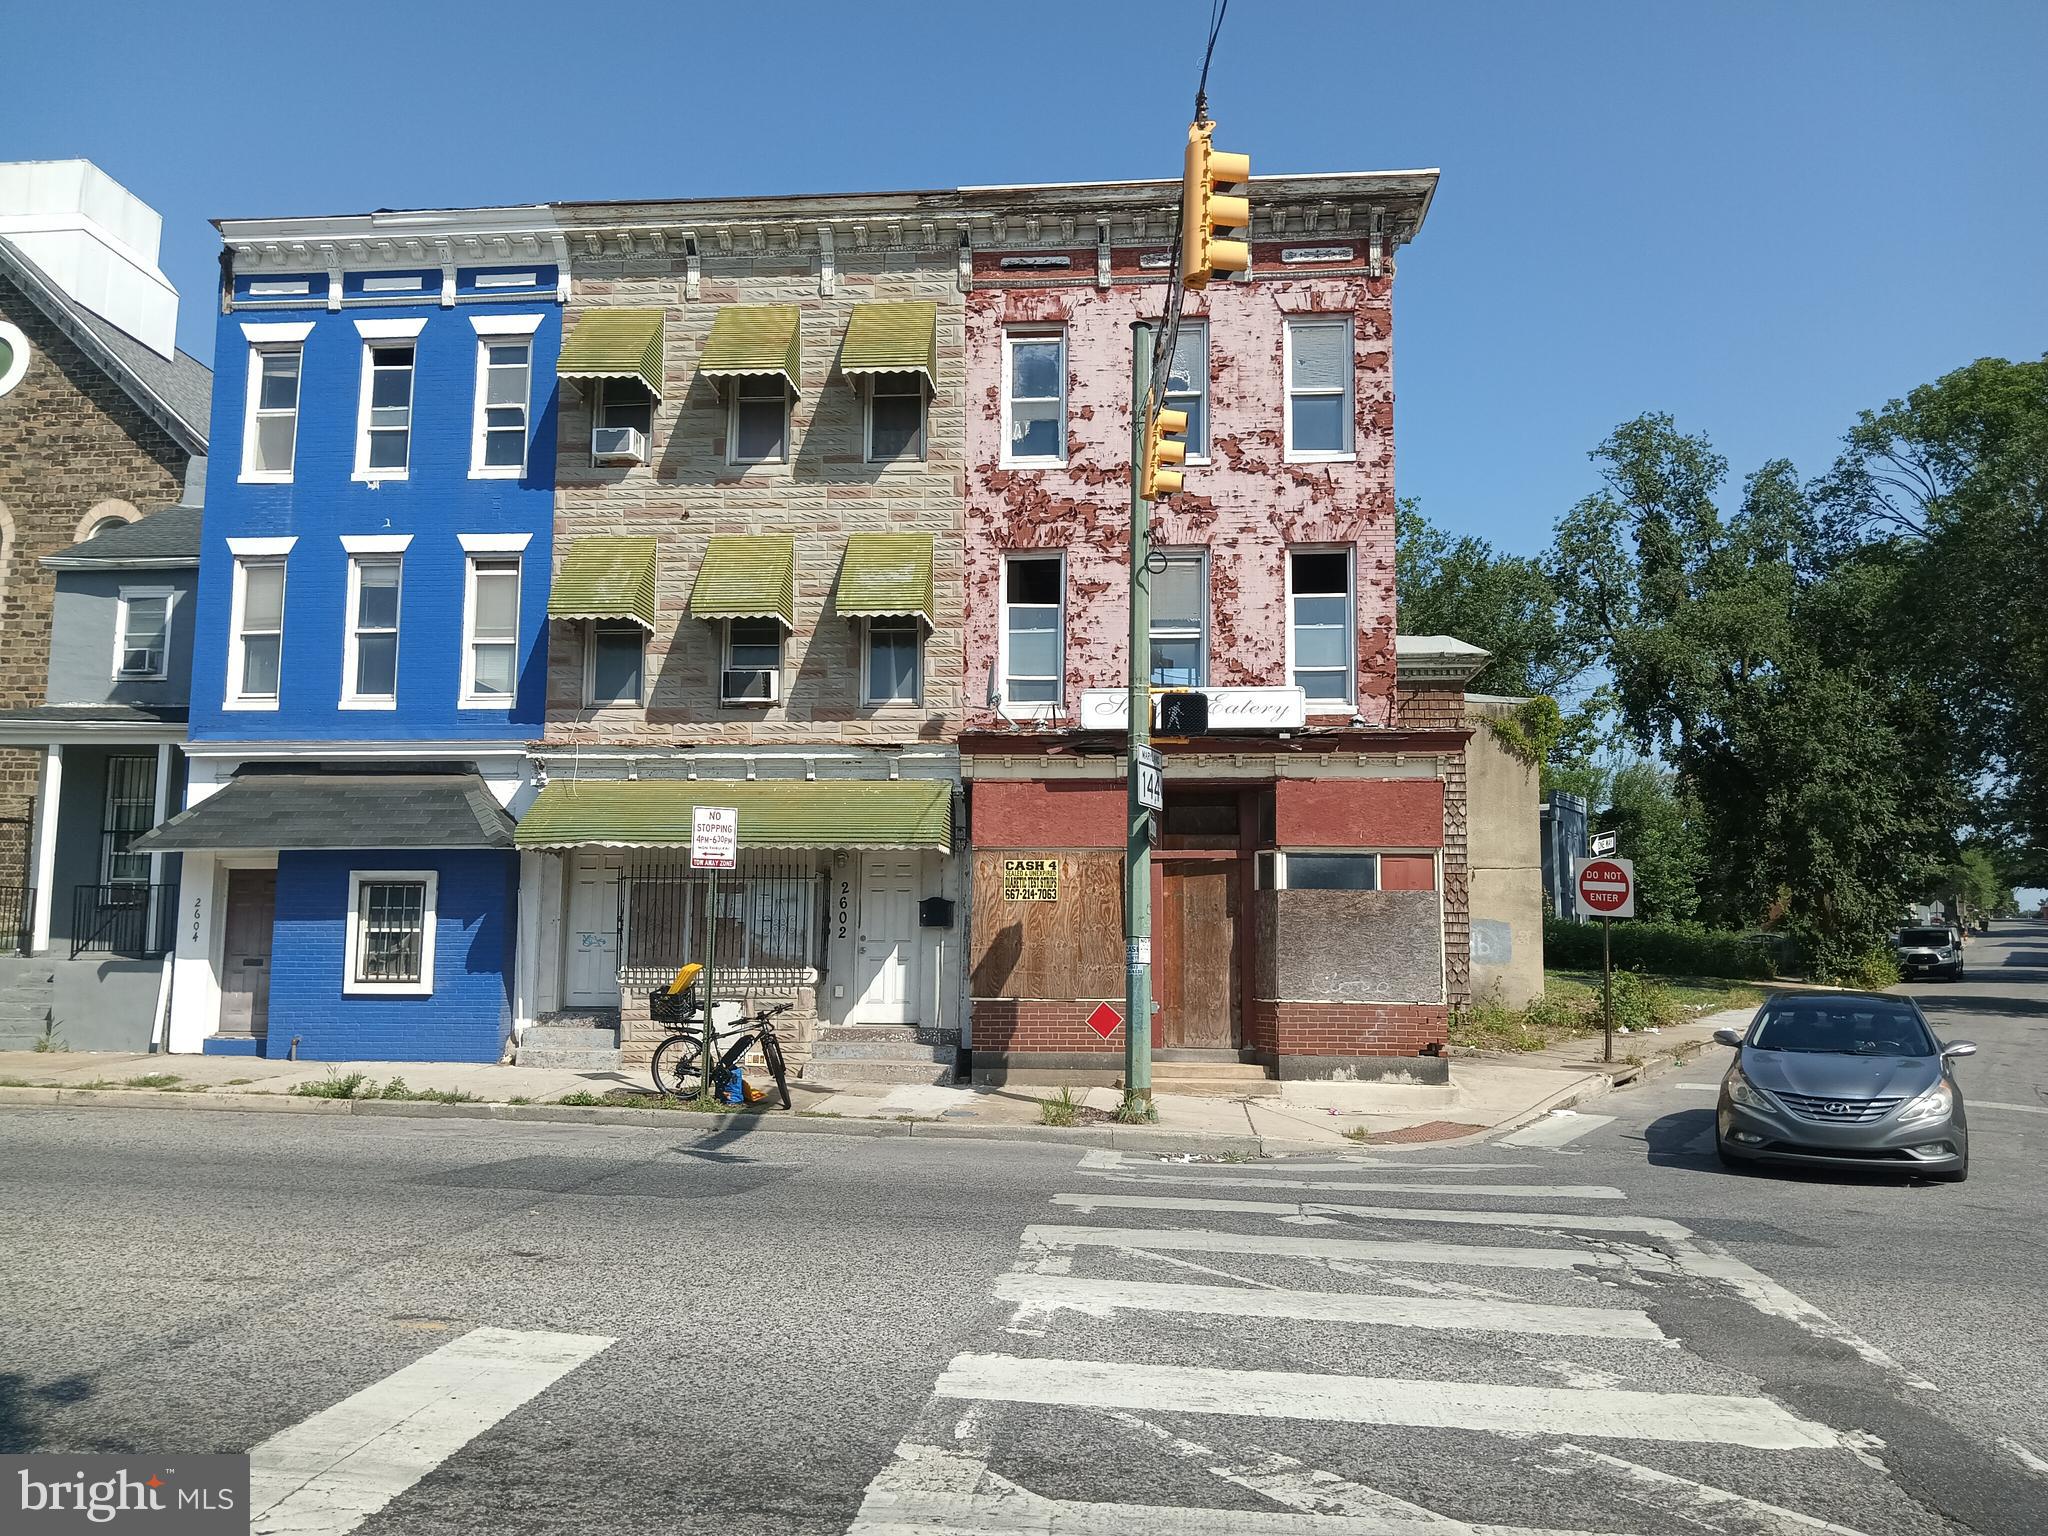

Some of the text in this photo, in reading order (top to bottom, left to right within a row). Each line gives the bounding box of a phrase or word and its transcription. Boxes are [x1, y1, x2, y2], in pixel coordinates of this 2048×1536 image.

[1208, 693, 1290, 722] Eatery
[1142, 771, 1160, 802] 144
[709, 811, 721, 821] NO
[697, 823, 733, 833] STOPPING
[1005, 861, 1057, 870] CASH 4
[1586, 870, 1622, 880] DO NOT
[1005, 877, 1057, 888] DIABETIC TEST STRIPS
[1005, 889, 1057, 900] 667-214-7063
[1590, 893, 1619, 903] ENTER
[838, 881, 850, 939] 2602
[192, 897, 202, 943] 2604
